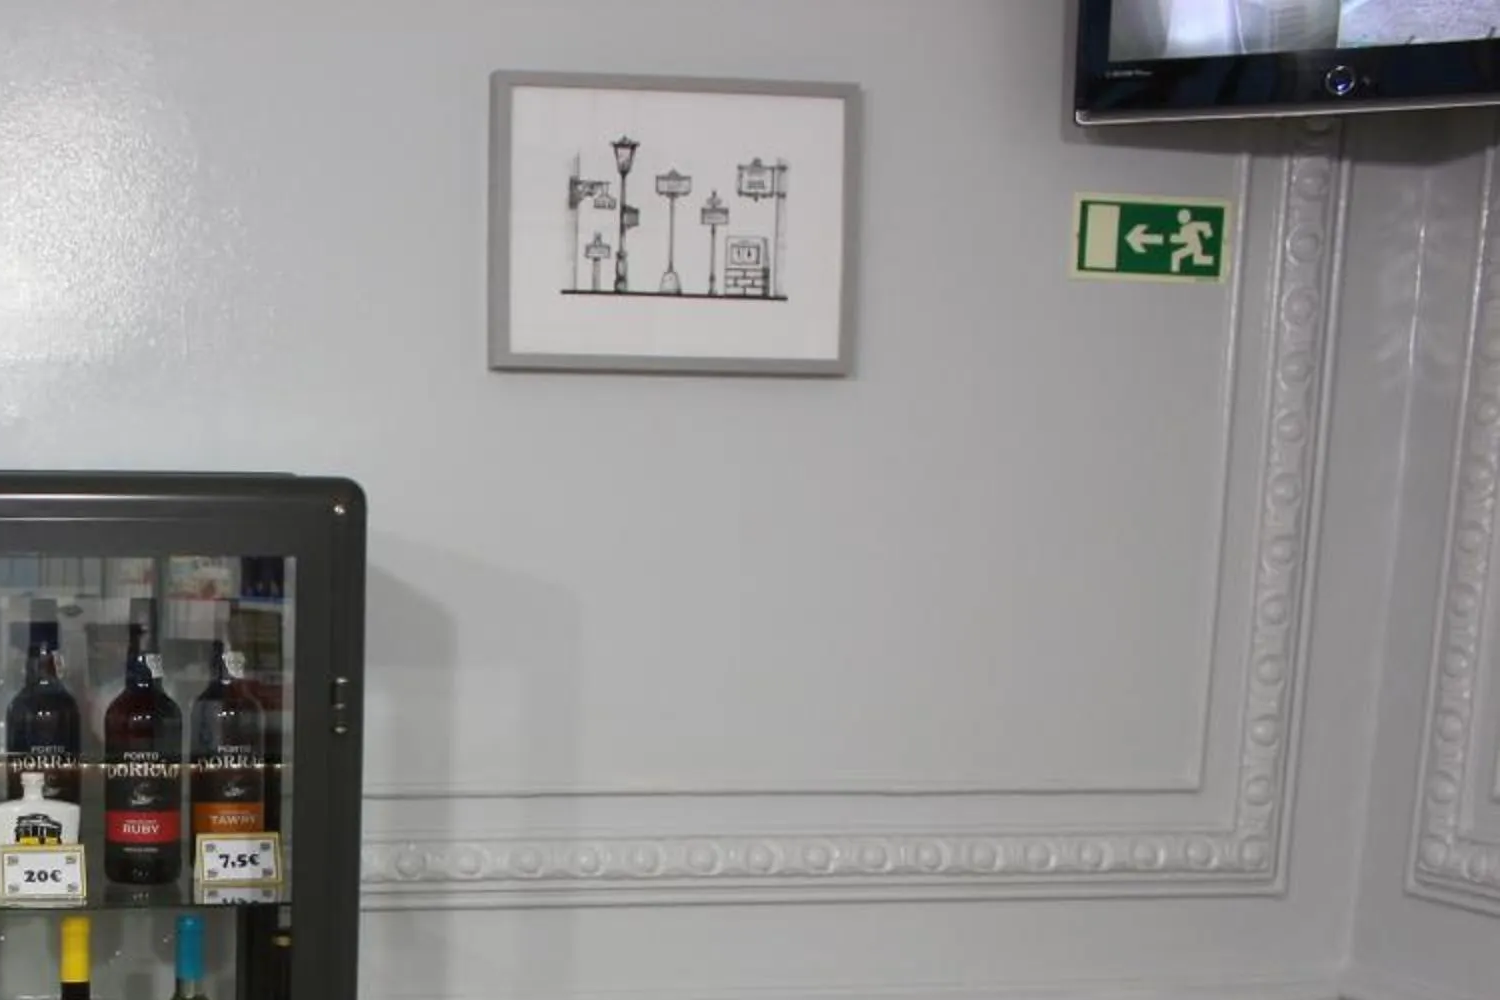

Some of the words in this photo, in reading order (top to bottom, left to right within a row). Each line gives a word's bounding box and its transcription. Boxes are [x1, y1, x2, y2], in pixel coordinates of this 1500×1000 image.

[30, 745, 66, 754] PORTO
[123, 751, 160, 762] PORTO
[122, 823, 160, 835] RUBY
[218, 853, 261, 869] 7,5€
[23, 868, 63, 884] 20€
